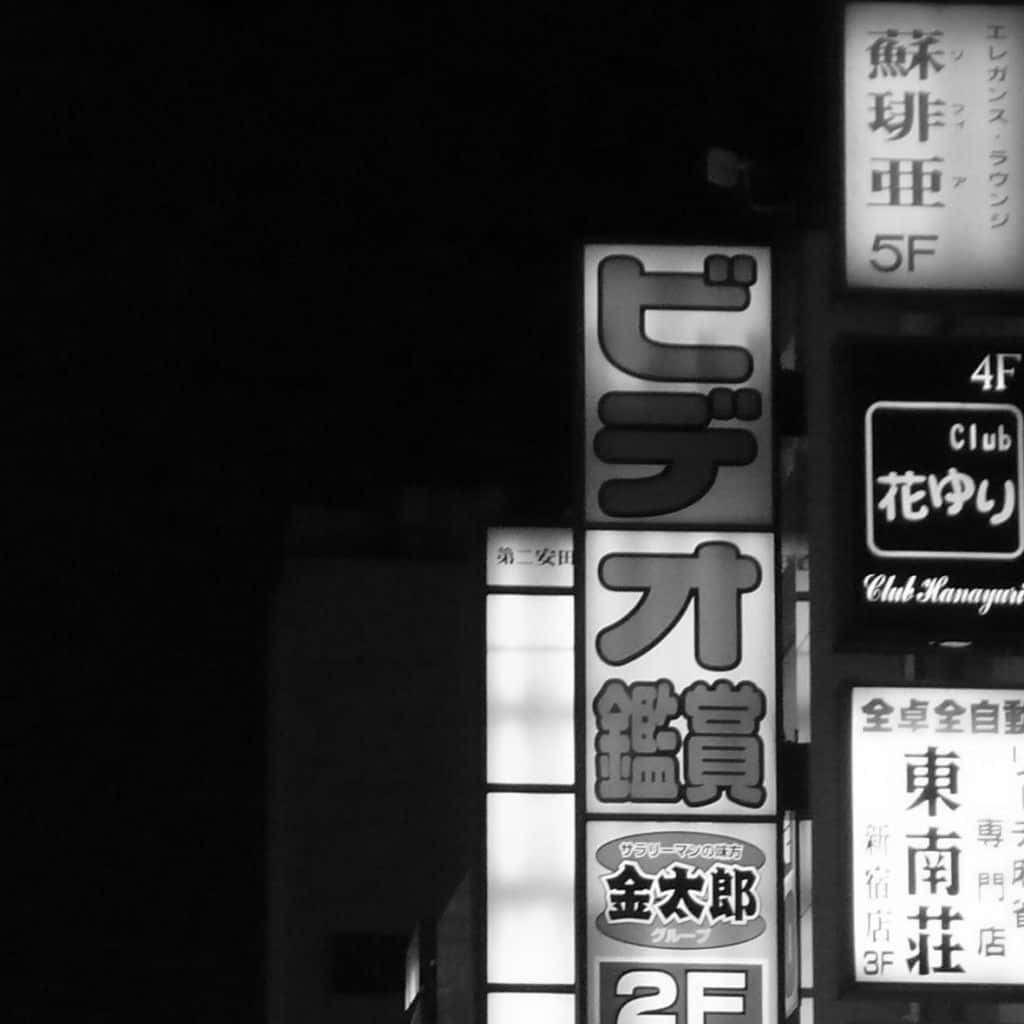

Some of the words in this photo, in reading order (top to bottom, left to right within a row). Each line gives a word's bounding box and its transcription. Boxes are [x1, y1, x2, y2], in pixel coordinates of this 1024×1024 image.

[870, 235, 938, 273] 5F
[971, 354, 1022, 391] 4F
[950, 423, 1011, 450] Club
[593, 253, 763, 672] ビデオ
[877, 468, 1015, 526] 花ゆり
[863, 574, 916, 604] Club
[593, 679, 767, 808] 鑑賞
[604, 861, 760, 925] 金太郎
[863, 952, 894, 976] 3F
